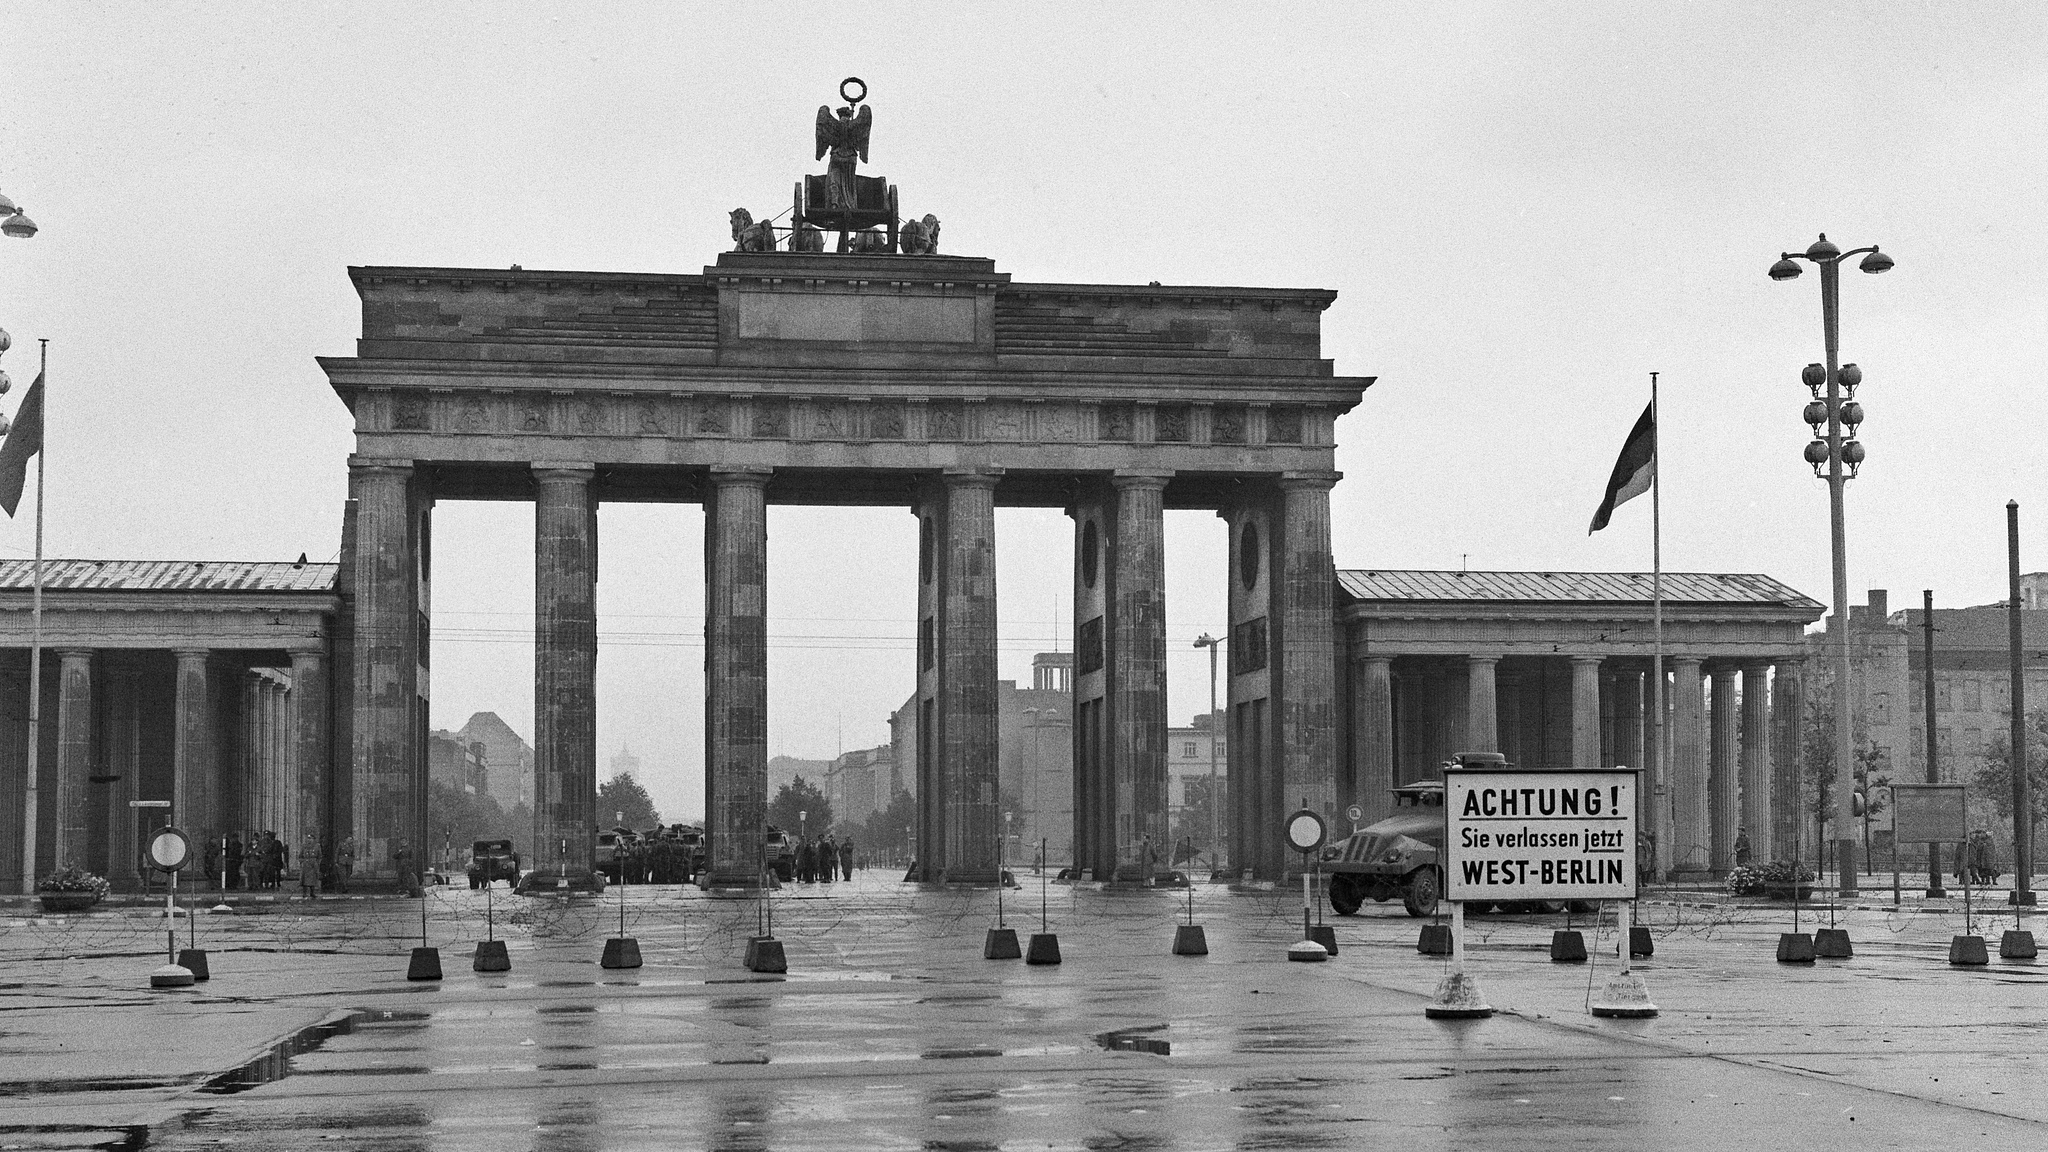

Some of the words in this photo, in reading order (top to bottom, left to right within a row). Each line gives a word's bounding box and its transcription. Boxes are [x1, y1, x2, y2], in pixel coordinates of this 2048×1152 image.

[1461, 827, 1490, 848] Sie
[1495, 826, 1579, 848] verlassen
[1582, 828, 1624, 853] jetzt
[1462, 859, 1622, 885] WEST-BERLIN
